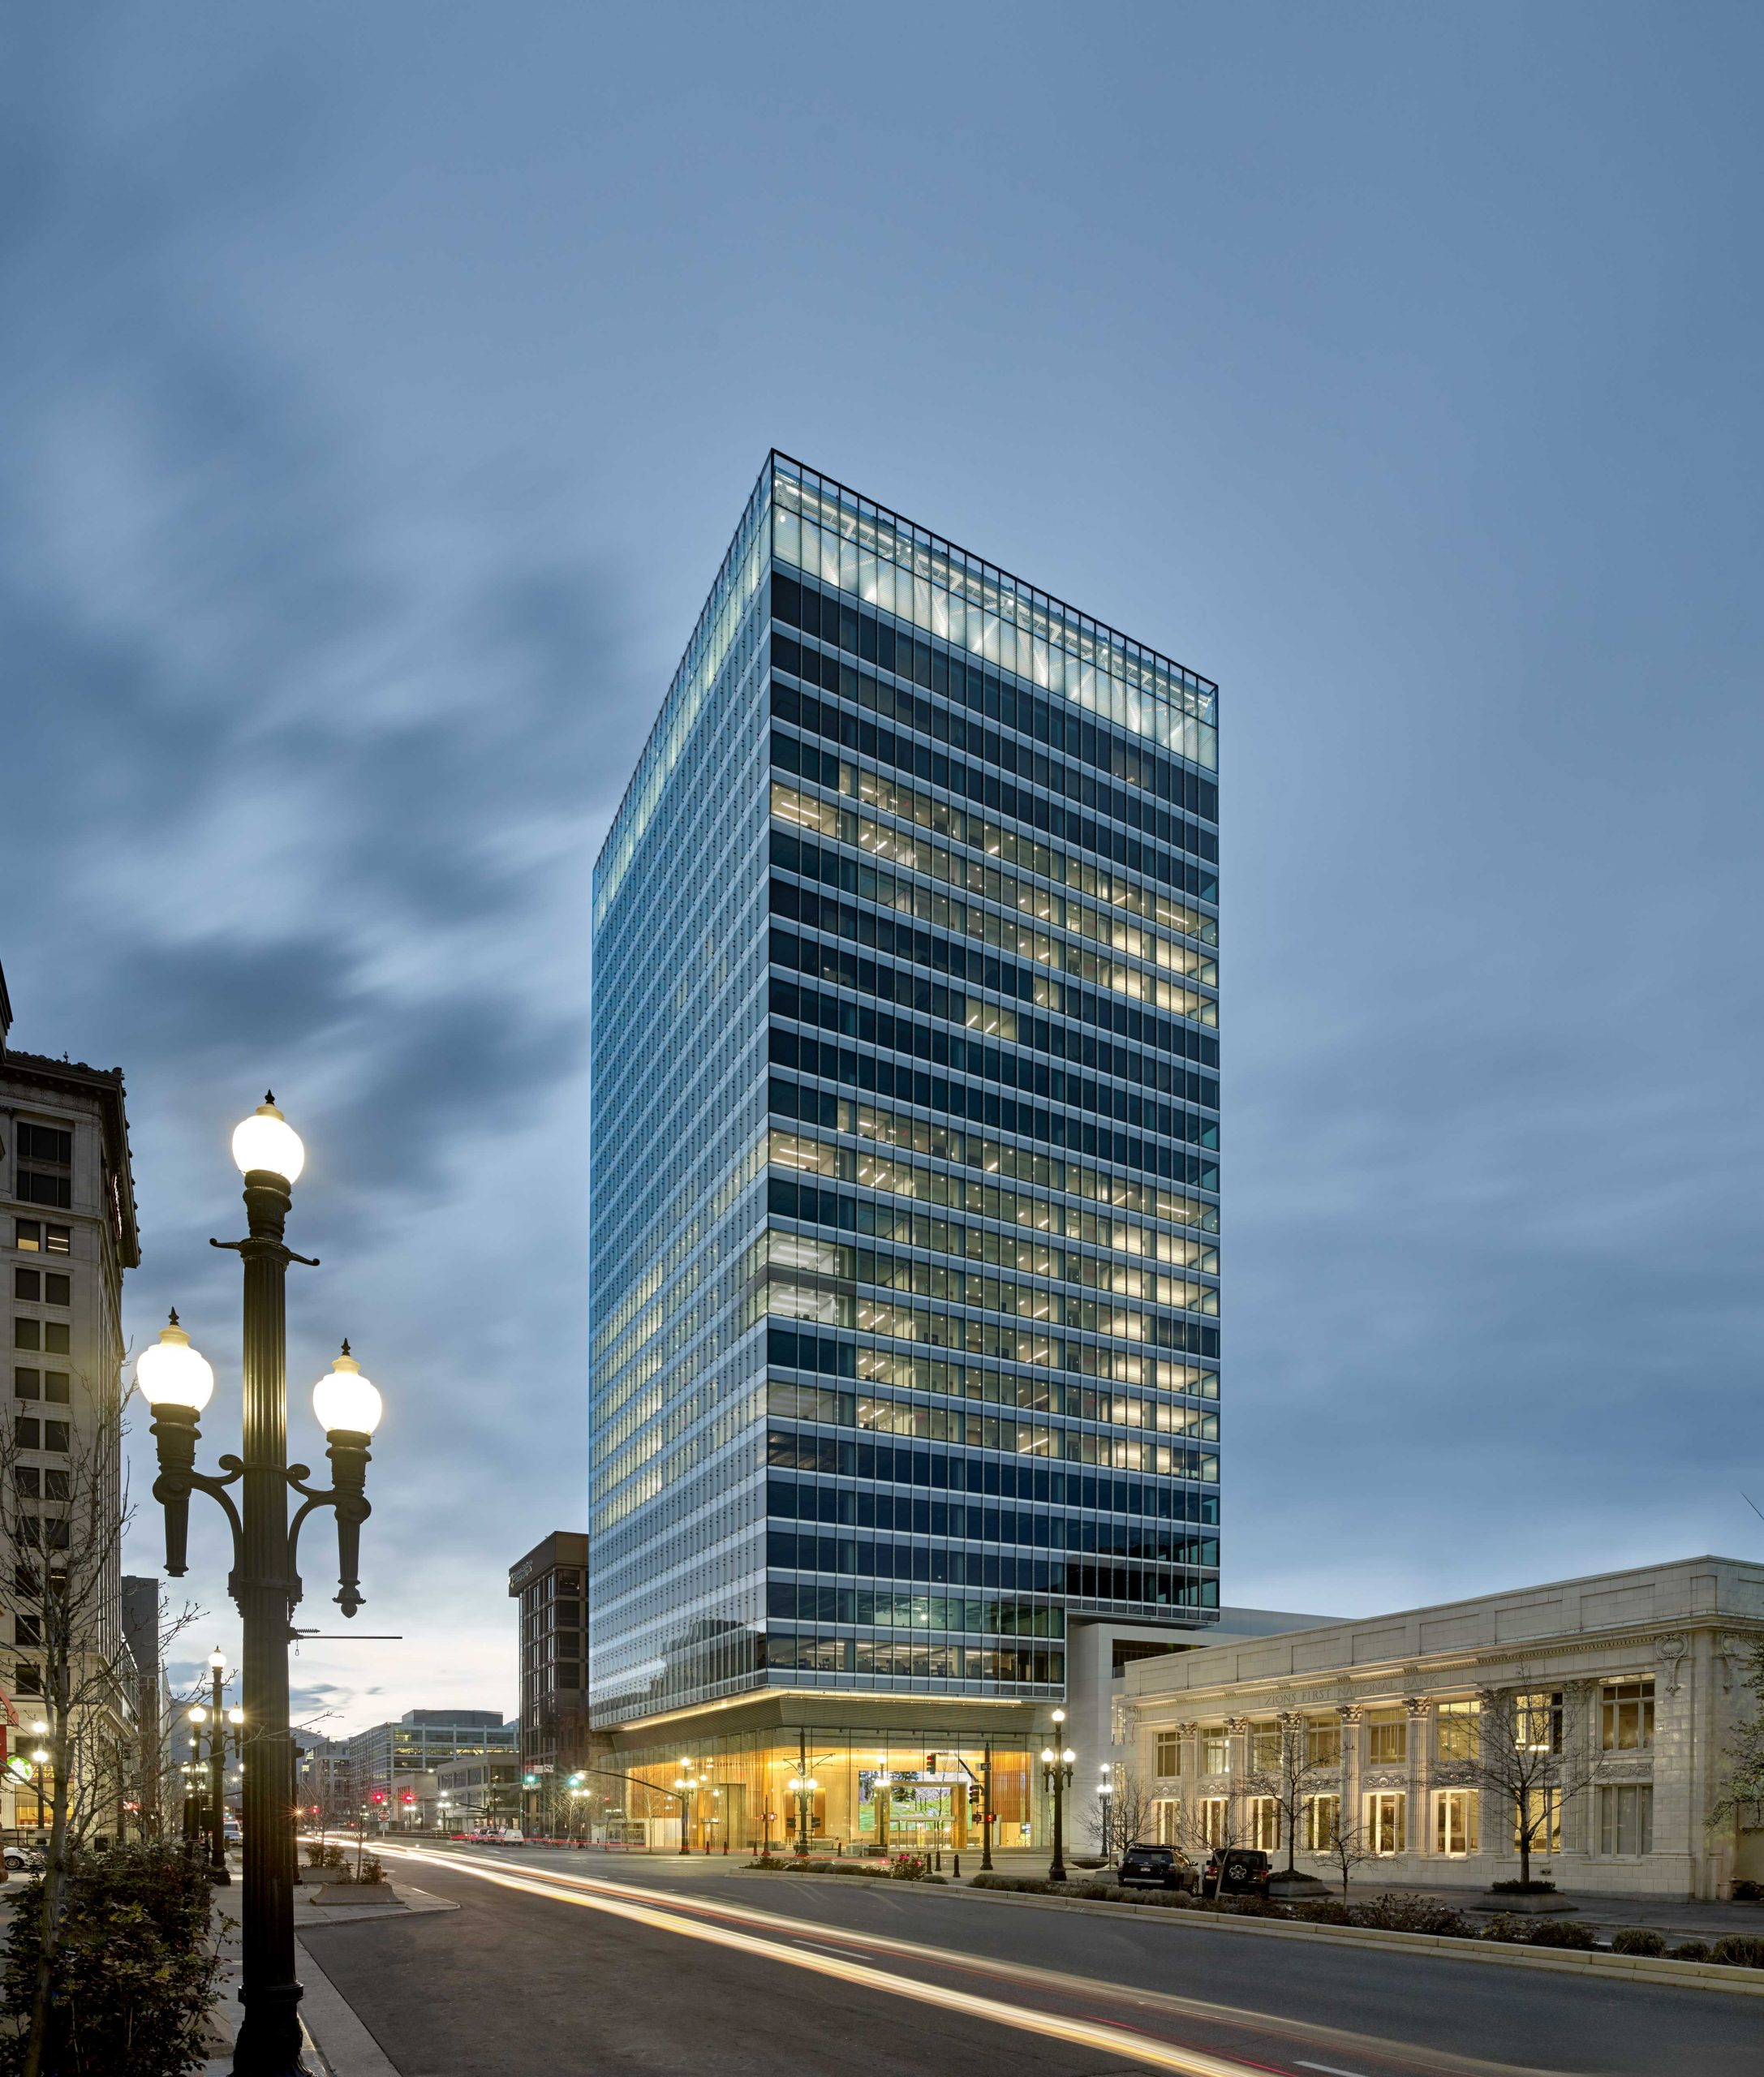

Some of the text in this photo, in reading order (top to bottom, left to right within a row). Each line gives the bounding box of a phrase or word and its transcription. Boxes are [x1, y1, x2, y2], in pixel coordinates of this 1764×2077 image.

[1265, 1675, 1439, 1705] ZIONS FIRST NATIONAL BANK
